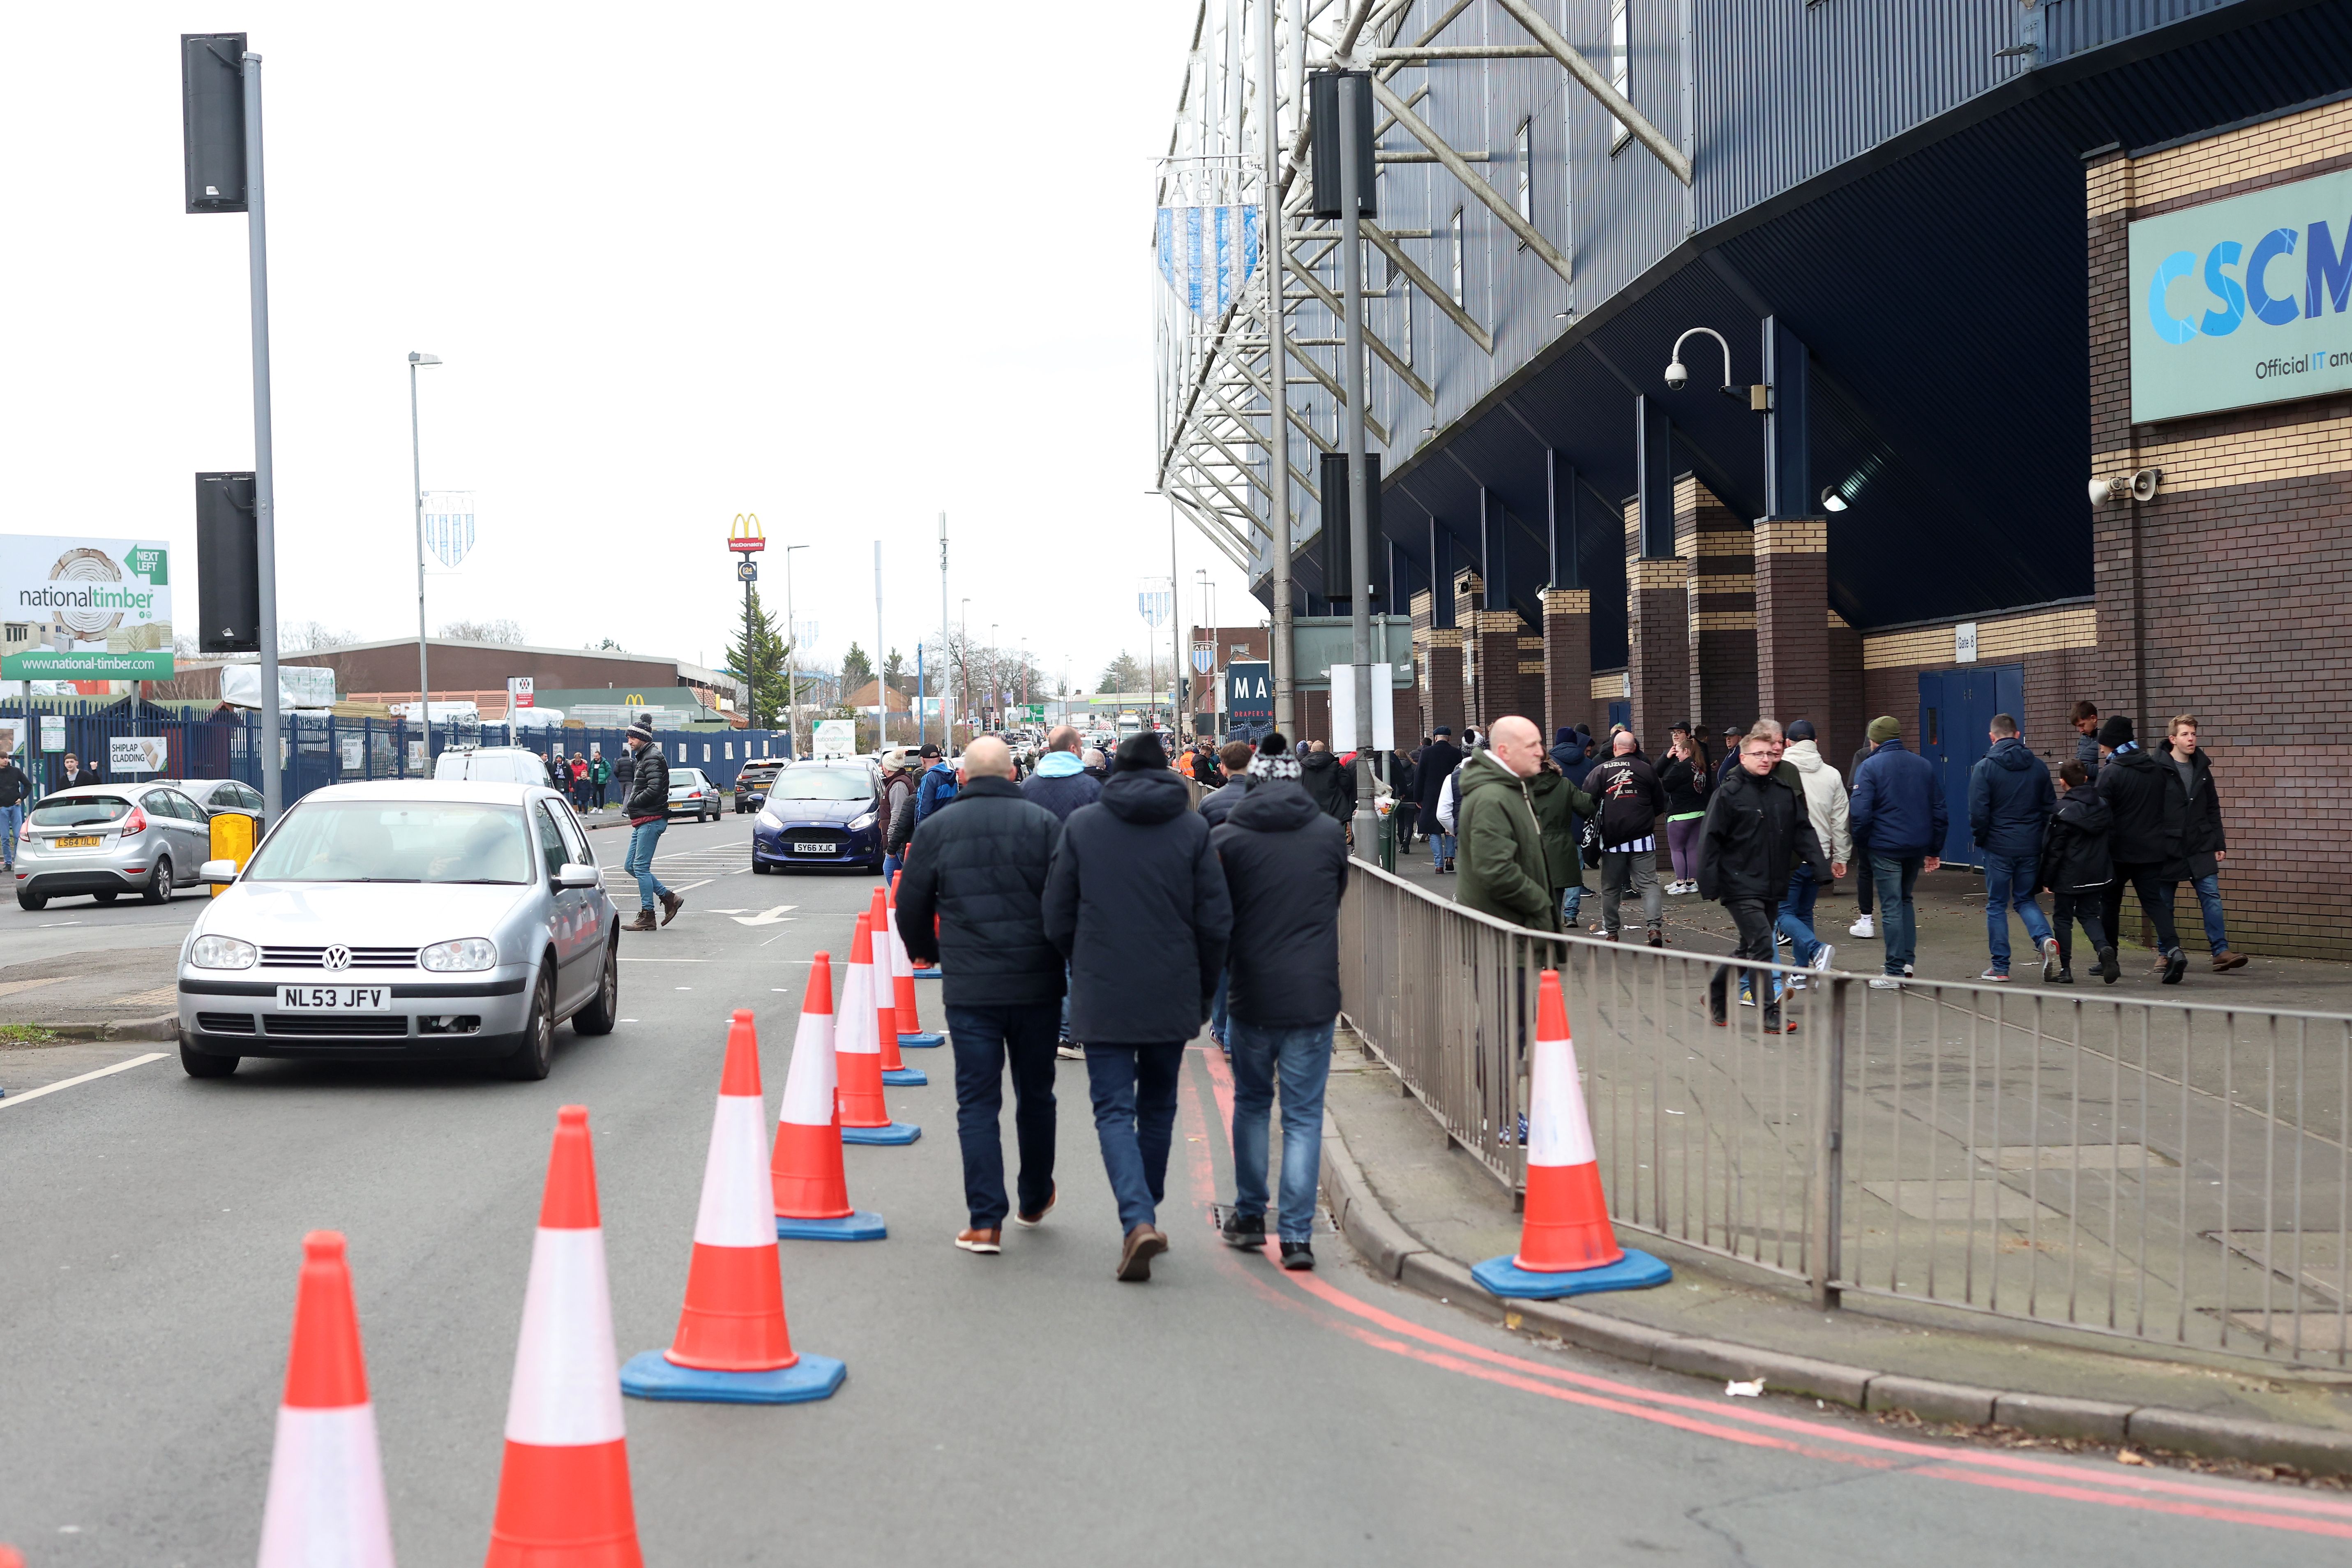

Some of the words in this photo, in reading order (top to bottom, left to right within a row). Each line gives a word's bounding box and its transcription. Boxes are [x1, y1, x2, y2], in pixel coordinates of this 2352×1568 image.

[2149, 215, 2352, 344] CSCM
[2256, 354, 2308, 379] Official
[2313, 351, 2326, 370] IT
[2330, 351, 2352, 367] an
[137, 551, 159, 561] NEXT
[137, 561, 157, 572] LEFT
[1958, 637, 1969, 649] Gate
[1971, 635, 1974, 648] 8
[22, 657, 154, 670] www.national-timber.com
[1235, 677, 1267, 699] MA
[286, 989, 336, 1007] NL53
[344, 989, 381, 1007] JFV
